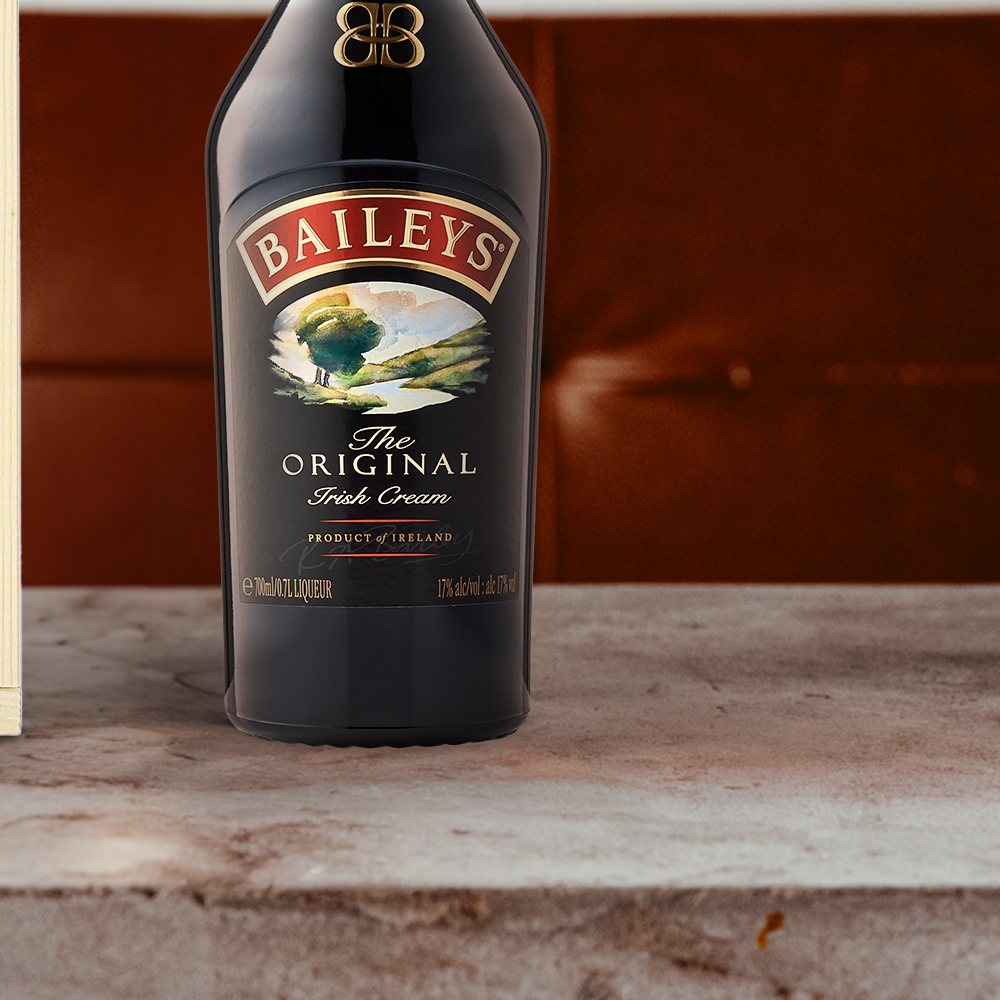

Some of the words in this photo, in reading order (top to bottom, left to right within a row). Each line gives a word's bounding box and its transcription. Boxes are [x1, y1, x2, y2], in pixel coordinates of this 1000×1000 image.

[255, 207, 500, 278] BAILEYS
[348, 425, 415, 451] The
[282, 452, 477, 476] ORIGINAL
[307, 486, 371, 506] Irish
[377, 485, 452, 505] Cream
[307, 533, 372, 543] PRODUCT
[375, 533, 389, 545] of
[392, 533, 453, 543] IRELAND
[293, 578, 333, 604] LIQUEUR
[438, 578, 454, 598] 17%
[454, 575, 480, 597] alc/vol
[485, 574, 496, 595] alc
